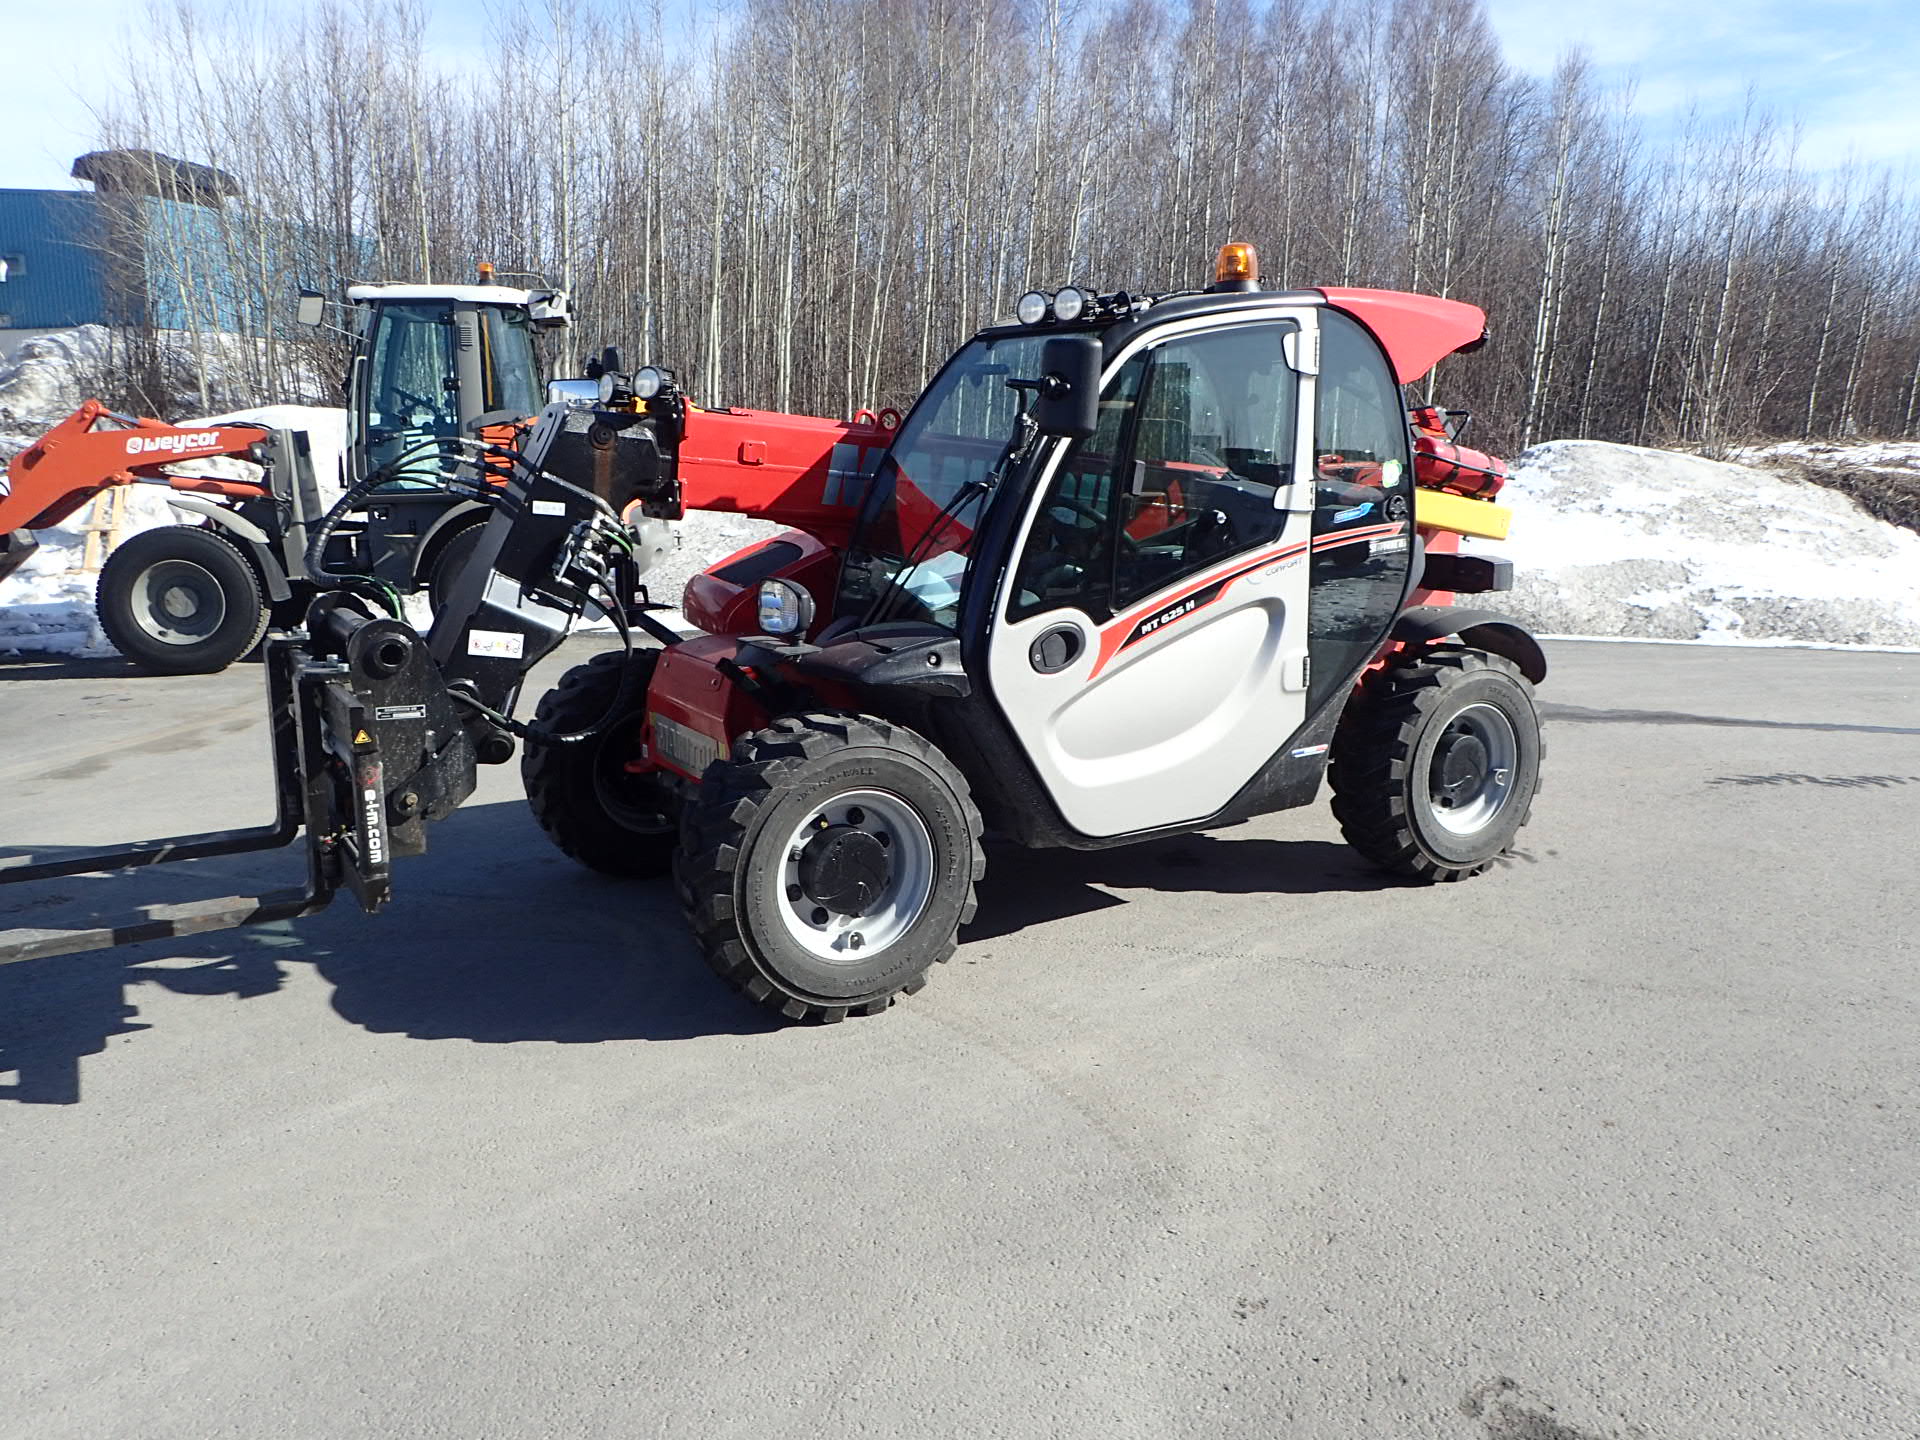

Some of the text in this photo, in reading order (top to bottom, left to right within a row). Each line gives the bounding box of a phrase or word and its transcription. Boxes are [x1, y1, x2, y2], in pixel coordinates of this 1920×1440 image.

[143, 432, 220, 453] weycor
[1141, 600, 1195, 635] MT 625 H
